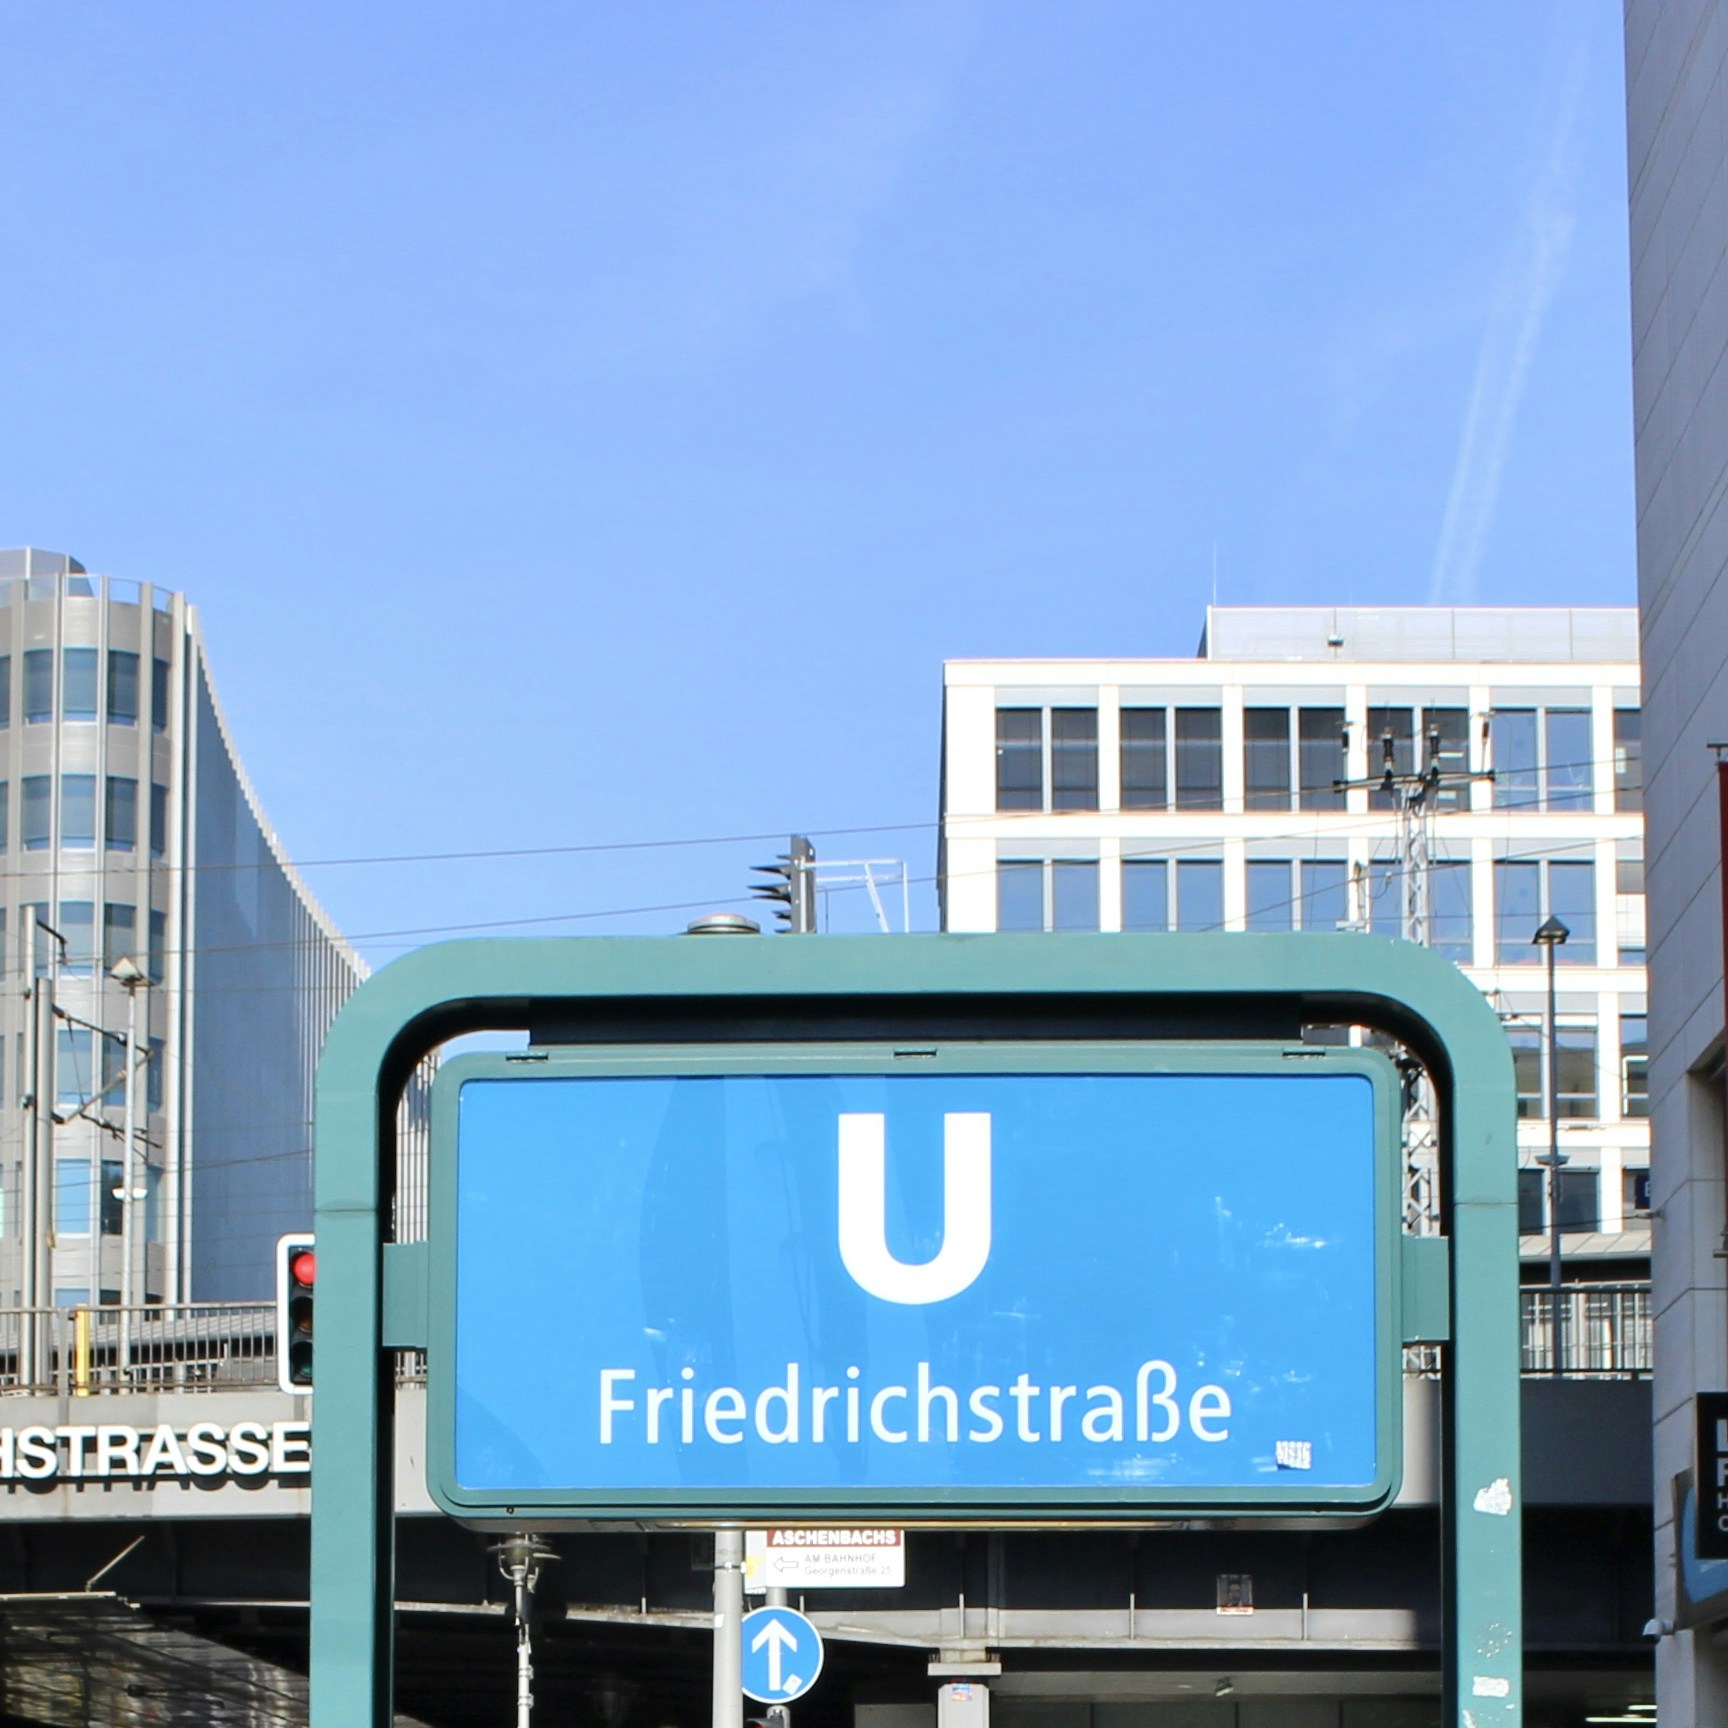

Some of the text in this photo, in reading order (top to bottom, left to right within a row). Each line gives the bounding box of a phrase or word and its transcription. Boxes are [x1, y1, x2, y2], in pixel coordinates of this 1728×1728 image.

[839, 1113, 991, 1304] U
[600, 1361, 1231, 1444] Friedrichstraße
[773, 1529, 897, 1545] ASCHENBACHS
[805, 1554, 876, 1563] AM BAHNHOF
[805, 1566, 877, 1576] Georgenstraße
